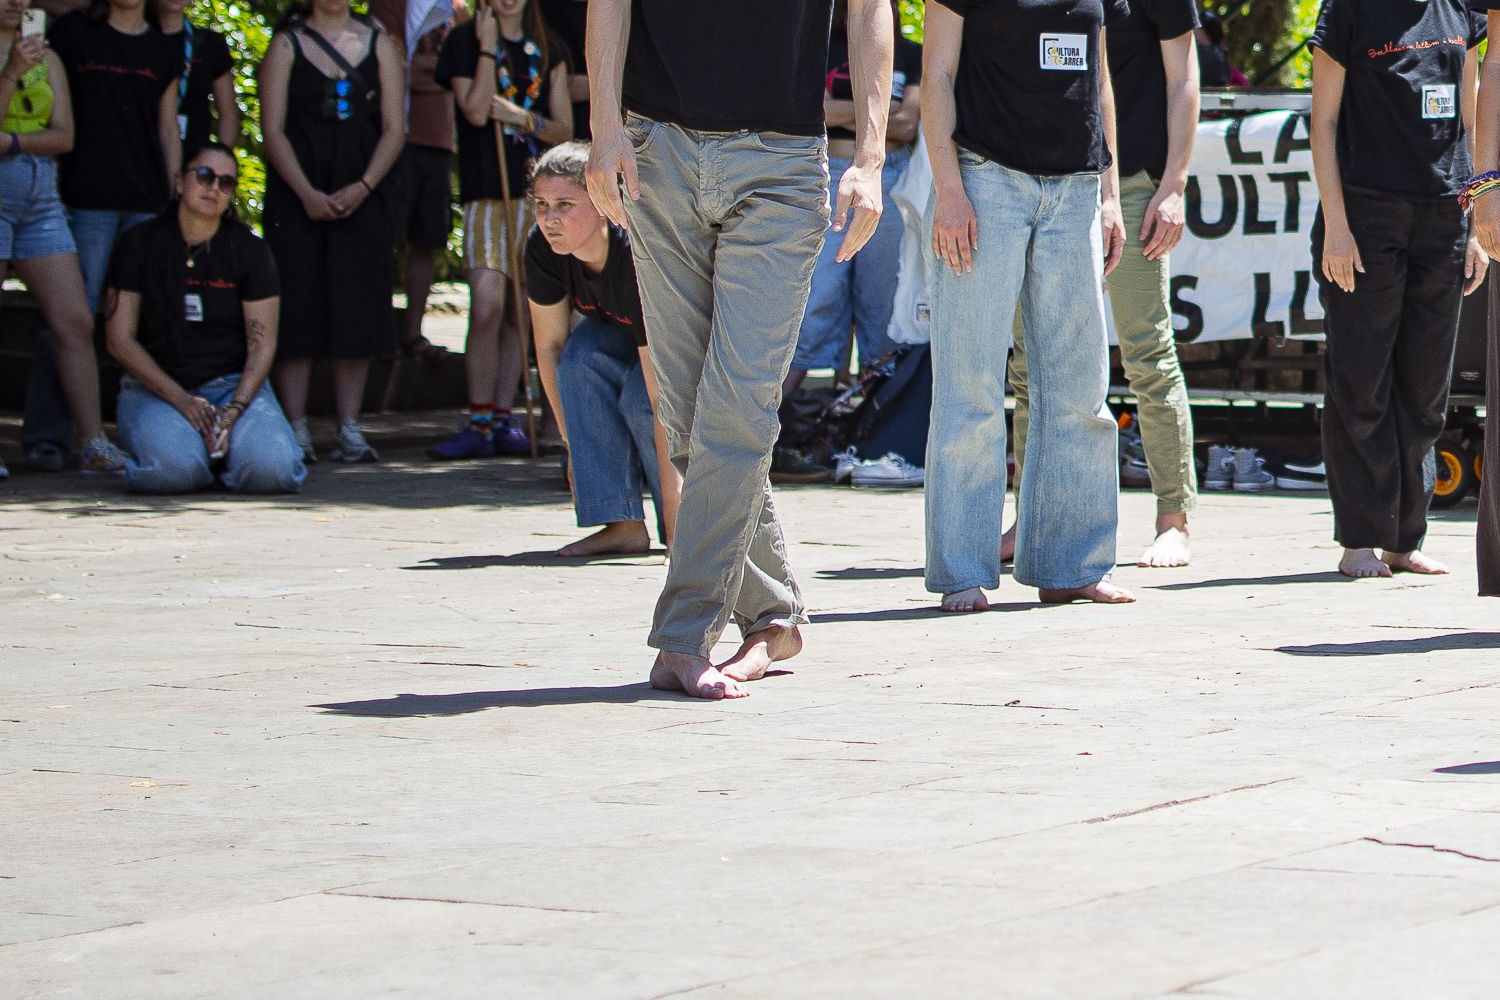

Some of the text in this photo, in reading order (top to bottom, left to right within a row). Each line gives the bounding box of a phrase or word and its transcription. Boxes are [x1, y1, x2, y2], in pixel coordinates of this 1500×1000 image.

[1048, 47, 1080, 57] CULTURA
[1224, 112, 1312, 165] LA
[1185, 171, 1312, 240] ULT
[1170, 270, 1327, 343] S LL
